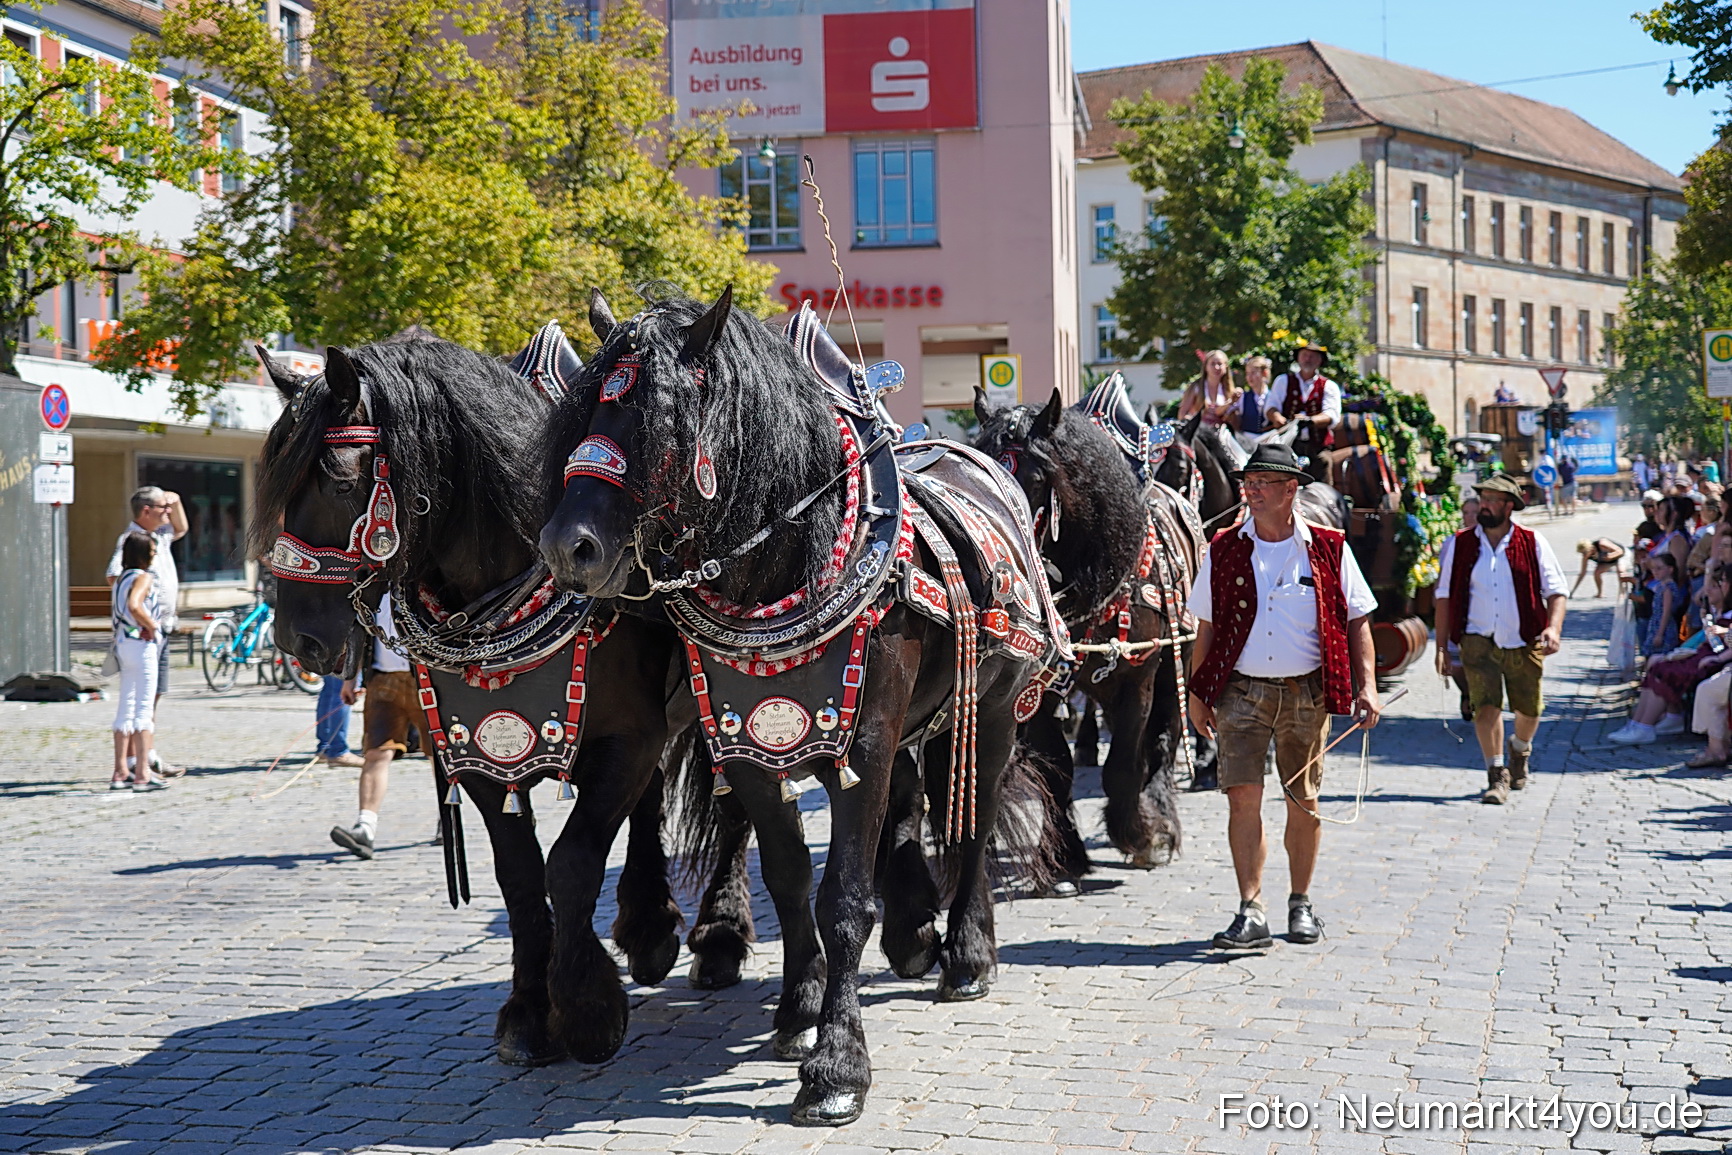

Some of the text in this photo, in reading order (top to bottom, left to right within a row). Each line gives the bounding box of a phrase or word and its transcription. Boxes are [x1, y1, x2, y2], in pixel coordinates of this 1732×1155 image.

[689, 44, 803, 66] Ausbildung
[690, 74, 768, 93] bei uns.
